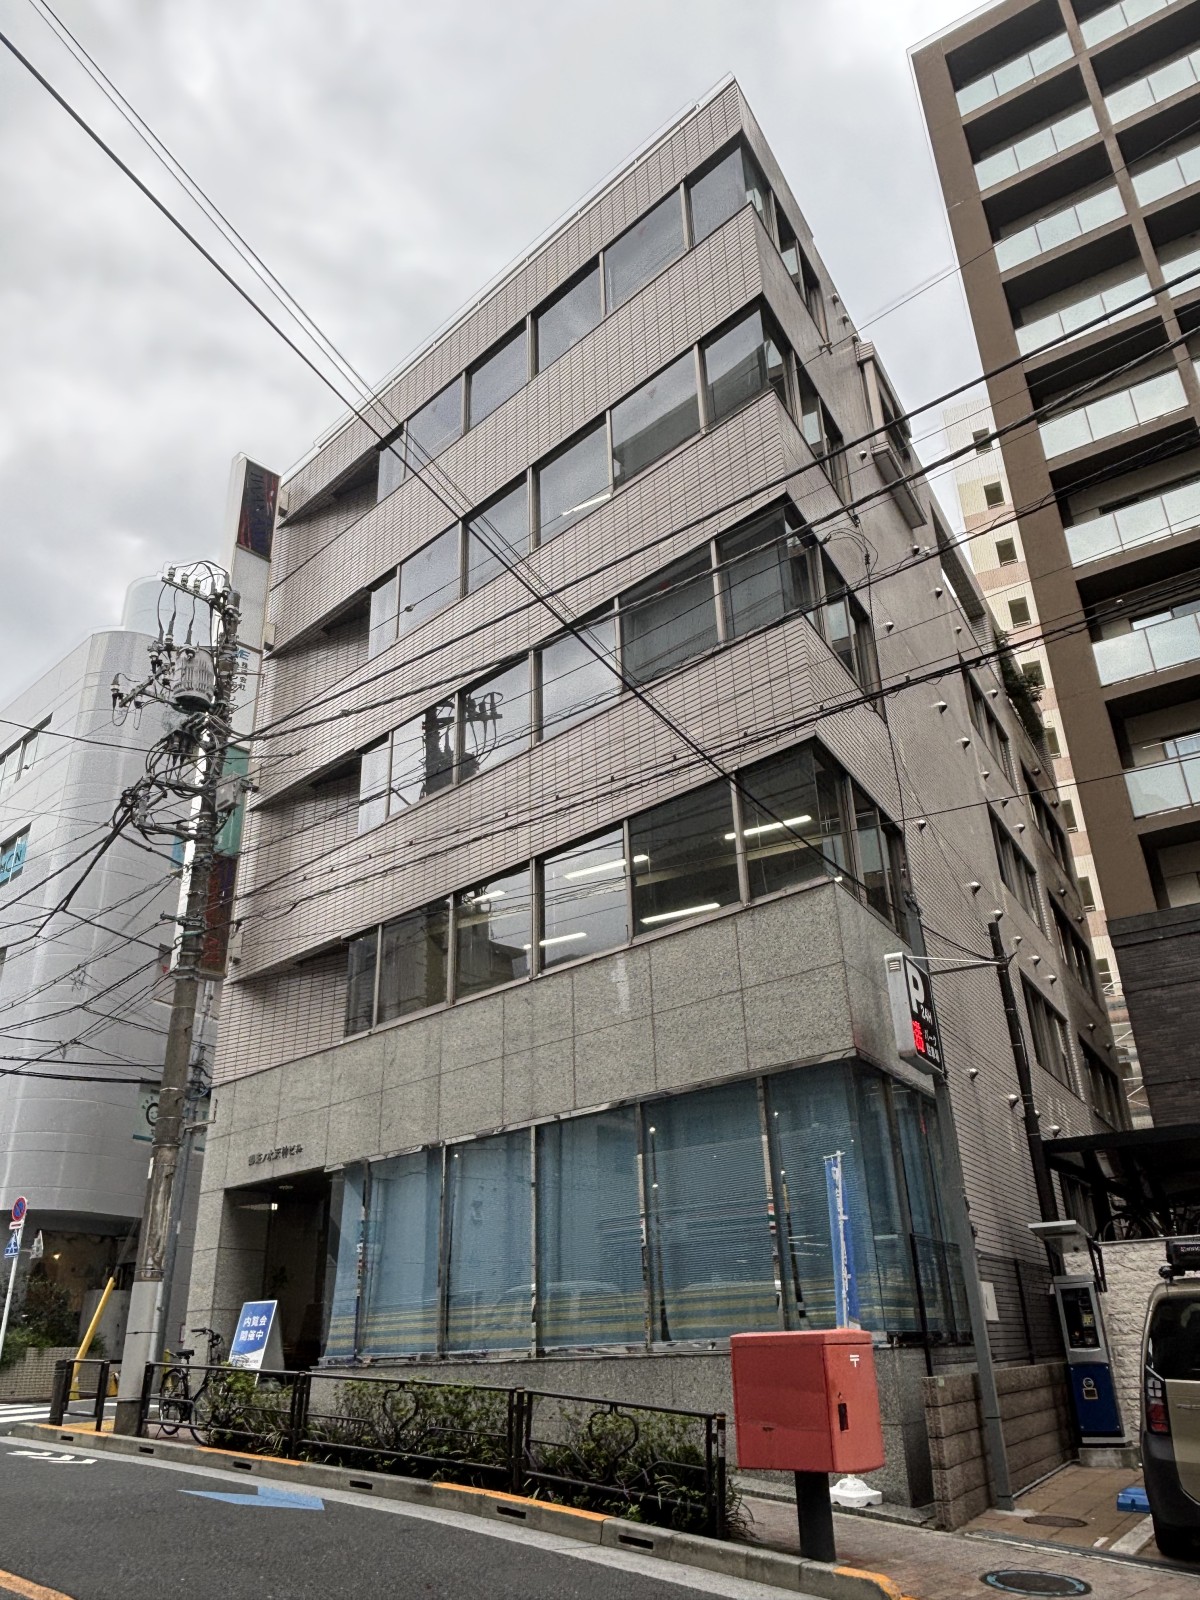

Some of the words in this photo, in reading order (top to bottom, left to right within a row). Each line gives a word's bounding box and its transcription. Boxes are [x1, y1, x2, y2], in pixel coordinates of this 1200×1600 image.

[905, 958, 925, 1014] P
[243, 1315, 268, 1328] 内覧会
[239, 1329, 264, 1342] 開催中
